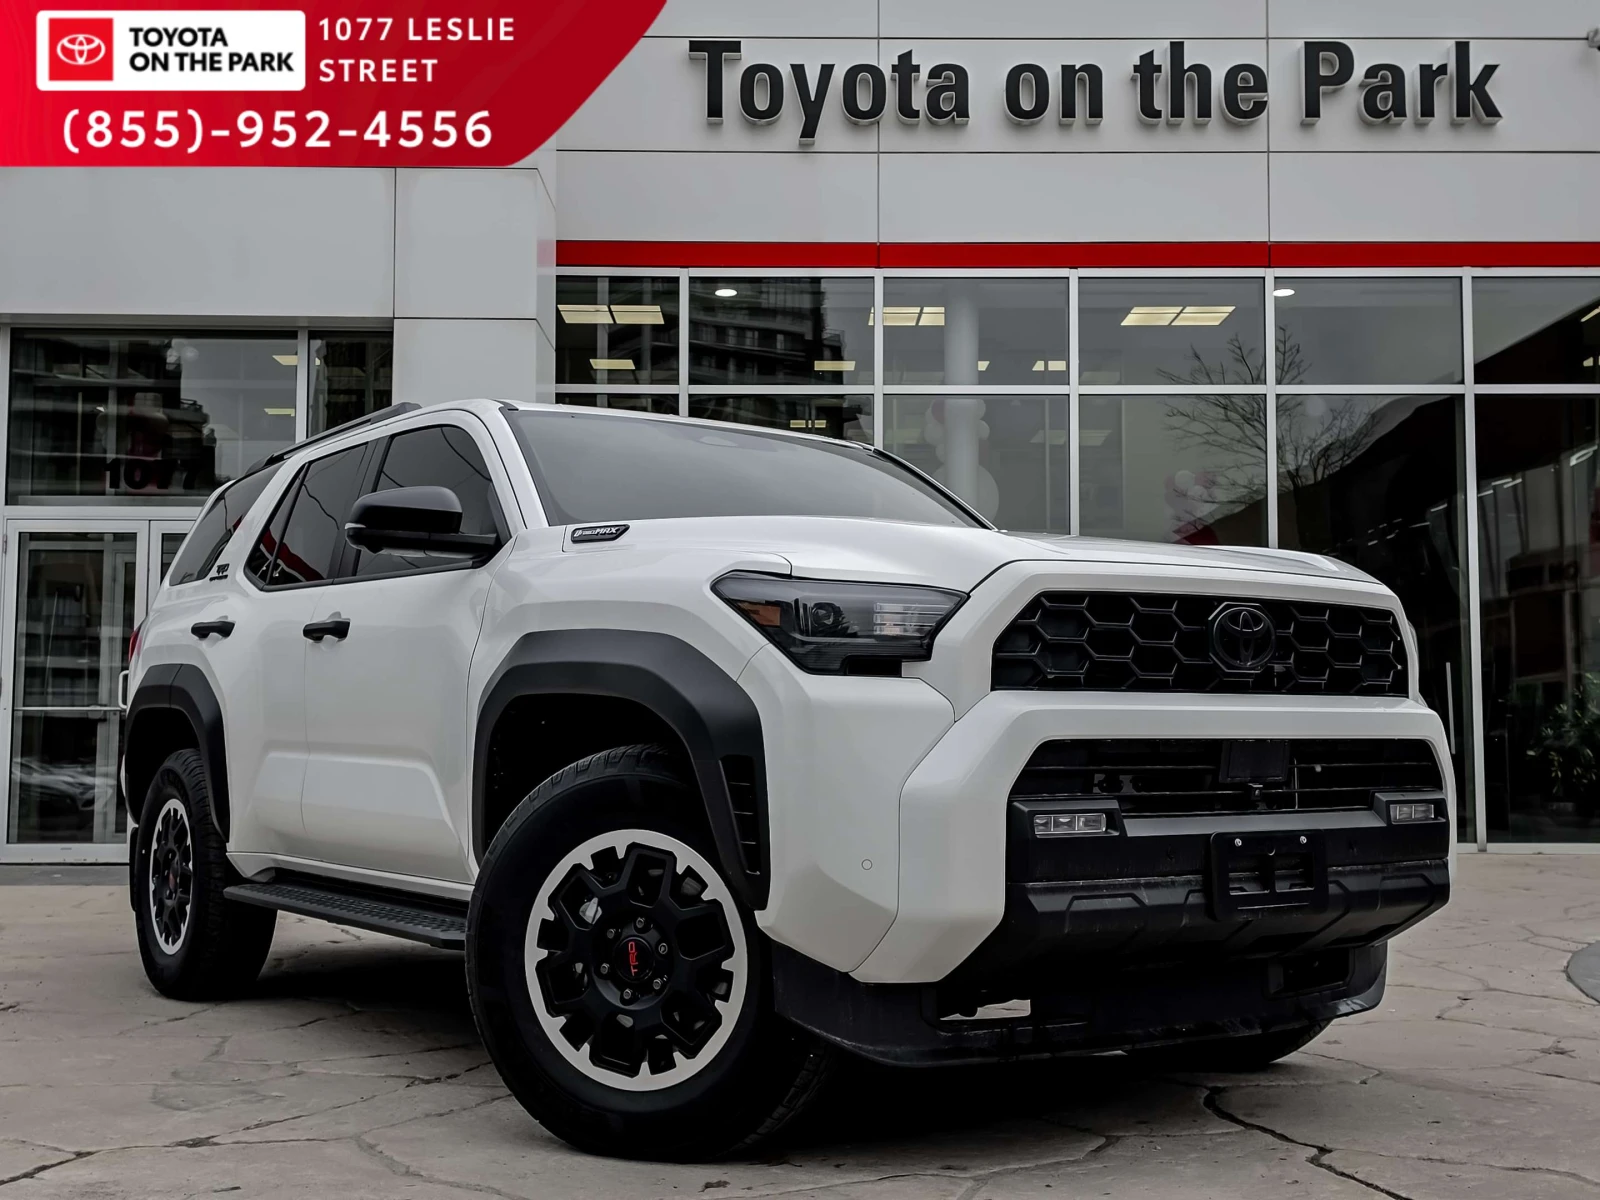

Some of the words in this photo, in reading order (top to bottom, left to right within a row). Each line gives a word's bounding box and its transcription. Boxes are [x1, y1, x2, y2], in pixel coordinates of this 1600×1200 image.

[689, 40, 970, 144] Toyota
[1005, 63, 1104, 126] on
[1131, 41, 1268, 126] the
[1301, 40, 1504, 126] Park
[628, 941, 639, 977] TRD
